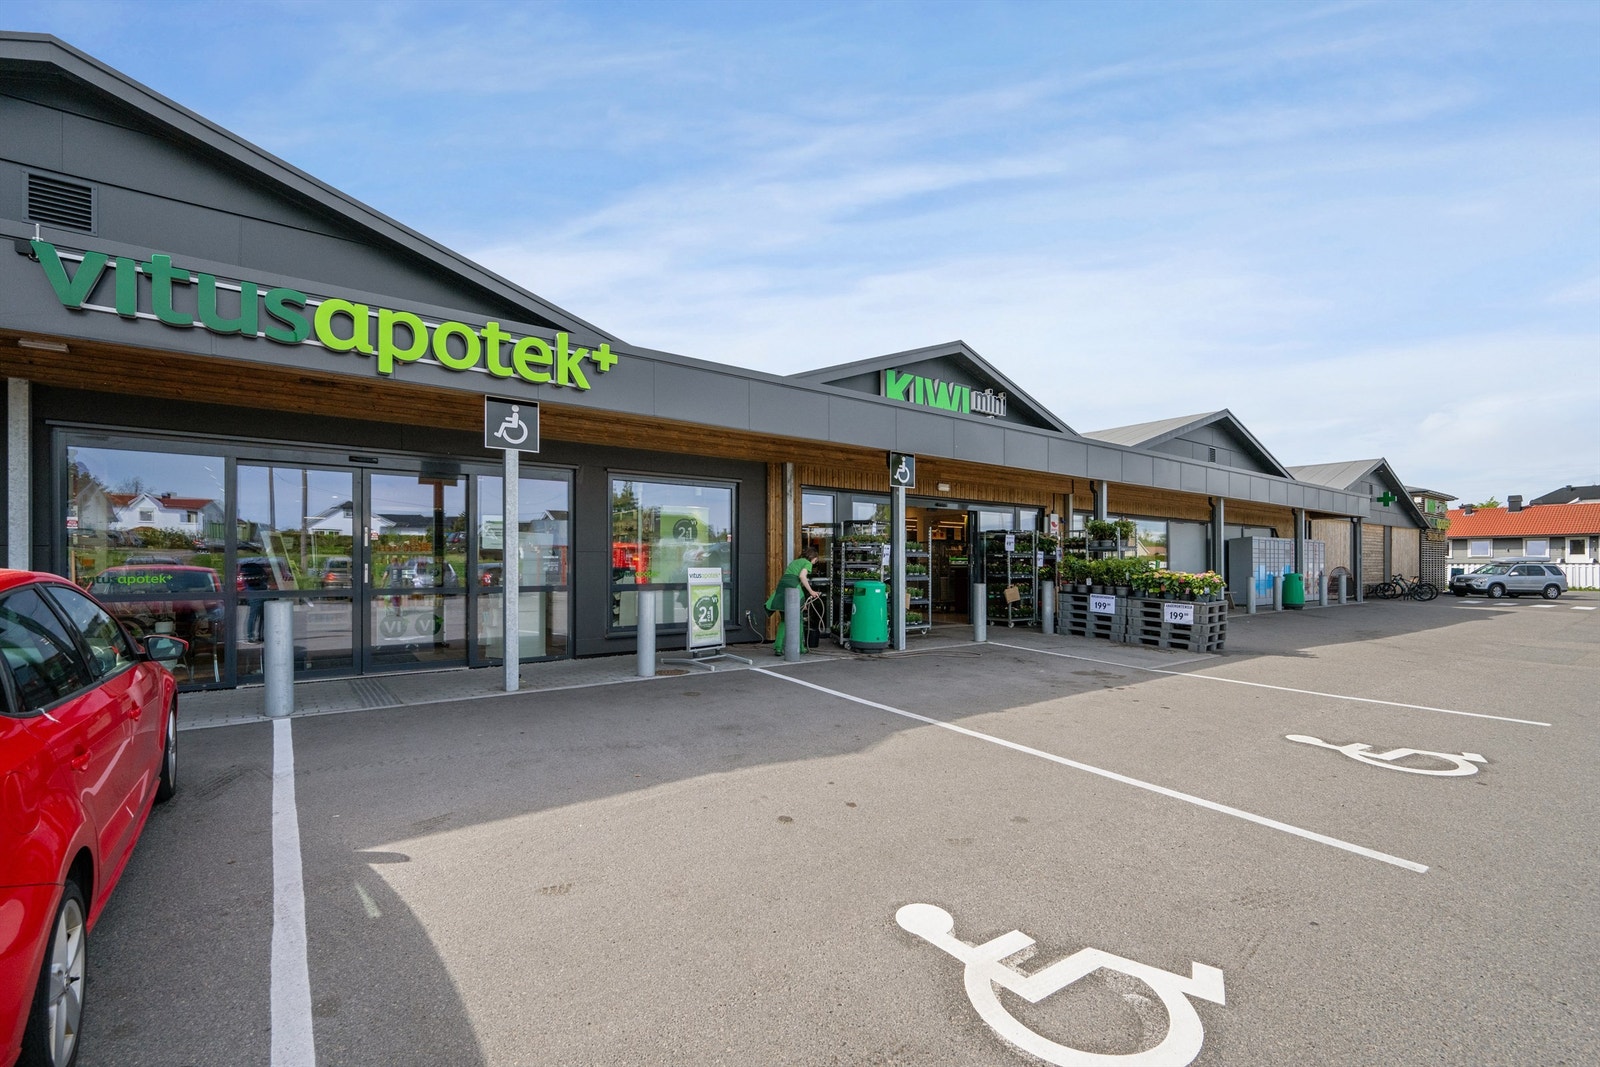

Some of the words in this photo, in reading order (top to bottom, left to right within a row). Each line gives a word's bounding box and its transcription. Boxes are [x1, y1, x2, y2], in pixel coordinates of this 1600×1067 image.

[885, 369, 971, 414] KIWI
[971, 388, 1007, 417] mini
[1095, 601, 1107, 610] 199
[699, 606, 707, 622] 2
[708, 606, 714, 622] 1
[1170, 611, 1184, 620] 199
